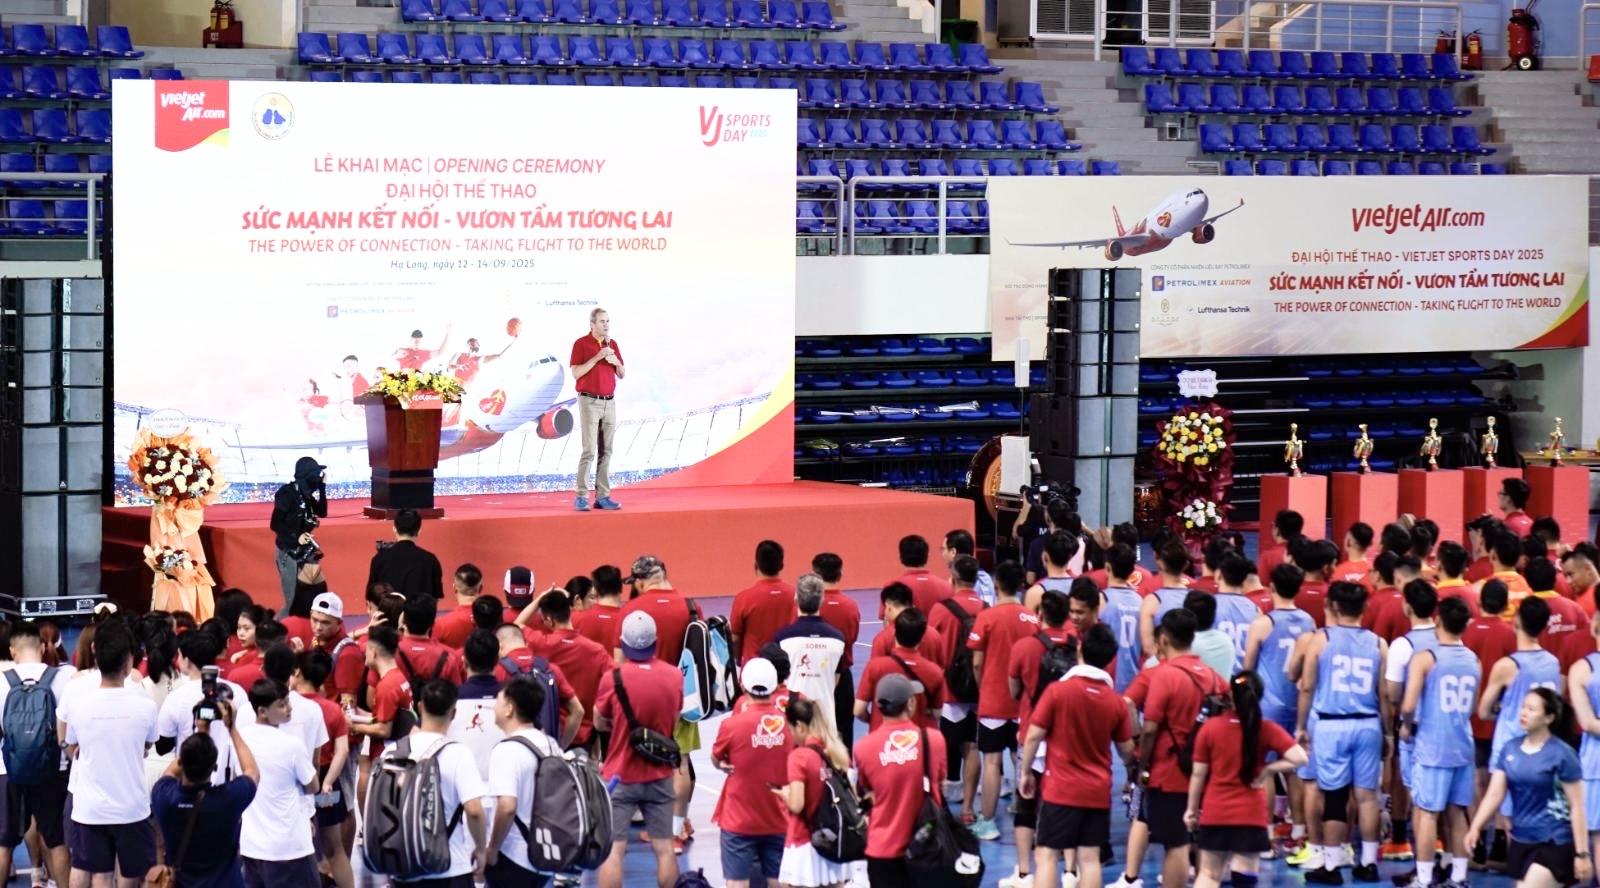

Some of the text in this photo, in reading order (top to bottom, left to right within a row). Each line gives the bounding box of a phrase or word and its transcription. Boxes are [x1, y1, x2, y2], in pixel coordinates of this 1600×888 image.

[699, 105, 724, 147] VJ
[726, 114, 771, 127] SPORTS
[723, 130, 748, 142] DAY
[314, 152, 606, 177] LỄ KHAI MẠC OPENING CEREMONY
[385, 183, 415, 202] ĐẠI
[419, 179, 449, 202] HỘI
[490, 183, 537, 199] THAO
[241, 204, 282, 230] SỨC
[286, 210, 353, 235] MẠNH
[358, 202, 397, 229] KẾT
[401, 202, 439, 229] NỐI
[456, 208, 516, 229] VƯƠN
[520, 202, 563, 229] TẦM
[567, 208, 637, 231] TƯƠNG
[641, 210, 673, 229] LAI
[248, 239, 276, 252] THE
[280, 239, 335, 252] POWER
[338, 238, 357, 252] OF
[360, 238, 451, 252] CONNECTION
[464, 238, 514, 253] TAKING
[518, 238, 564, 252] FLIGHT
[567, 238, 584, 251] TO
[588, 238, 613, 251] THE
[617, 237, 667, 251] WORLD
[458, 258, 468, 269] 12
[1291, 251, 1311, 265] ĐẠI
[1314, 248, 1334, 265] HỘI
[1361, 251, 1392, 262] THAO
[1402, 251, 1445, 262] VIETJET
[1448, 250, 1491, 261] SPORTS
[1493, 249, 1515, 261] DAY
[1517, 249, 1544, 260] 2025
[1166, 279, 1251, 287] PETROLIMEX AVIATION
[1269, 271, 1297, 291] SỨC
[1299, 275, 1345, 294] MẠNH
[1347, 268, 1375, 290] KẾT
[1377, 268, 1404, 290] NỐI
[1415, 272, 1456, 289] VƯƠN
[1459, 267, 1489, 288] TẦM
[1491, 271, 1540, 288] TƯƠNG
[1543, 272, 1565, 287] LAI
[1197, 305, 1250, 314] Lufthansa Technik
[1274, 302, 1293, 313] THE
[1295, 301, 1332, 313] POWER
[1334, 301, 1348, 312] OF
[1349, 300, 1412, 312] CONNECTION
[1421, 300, 1455, 311] TAKING
[1457, 299, 1490, 311] FLIGHT
[1492, 299, 1503, 310] TO
[1506, 298, 1524, 309] THE
[1526, 297, 1561, 309] WORLD
[1332, 654, 1373, 695] 25
[1440, 675, 1476, 713] 66
